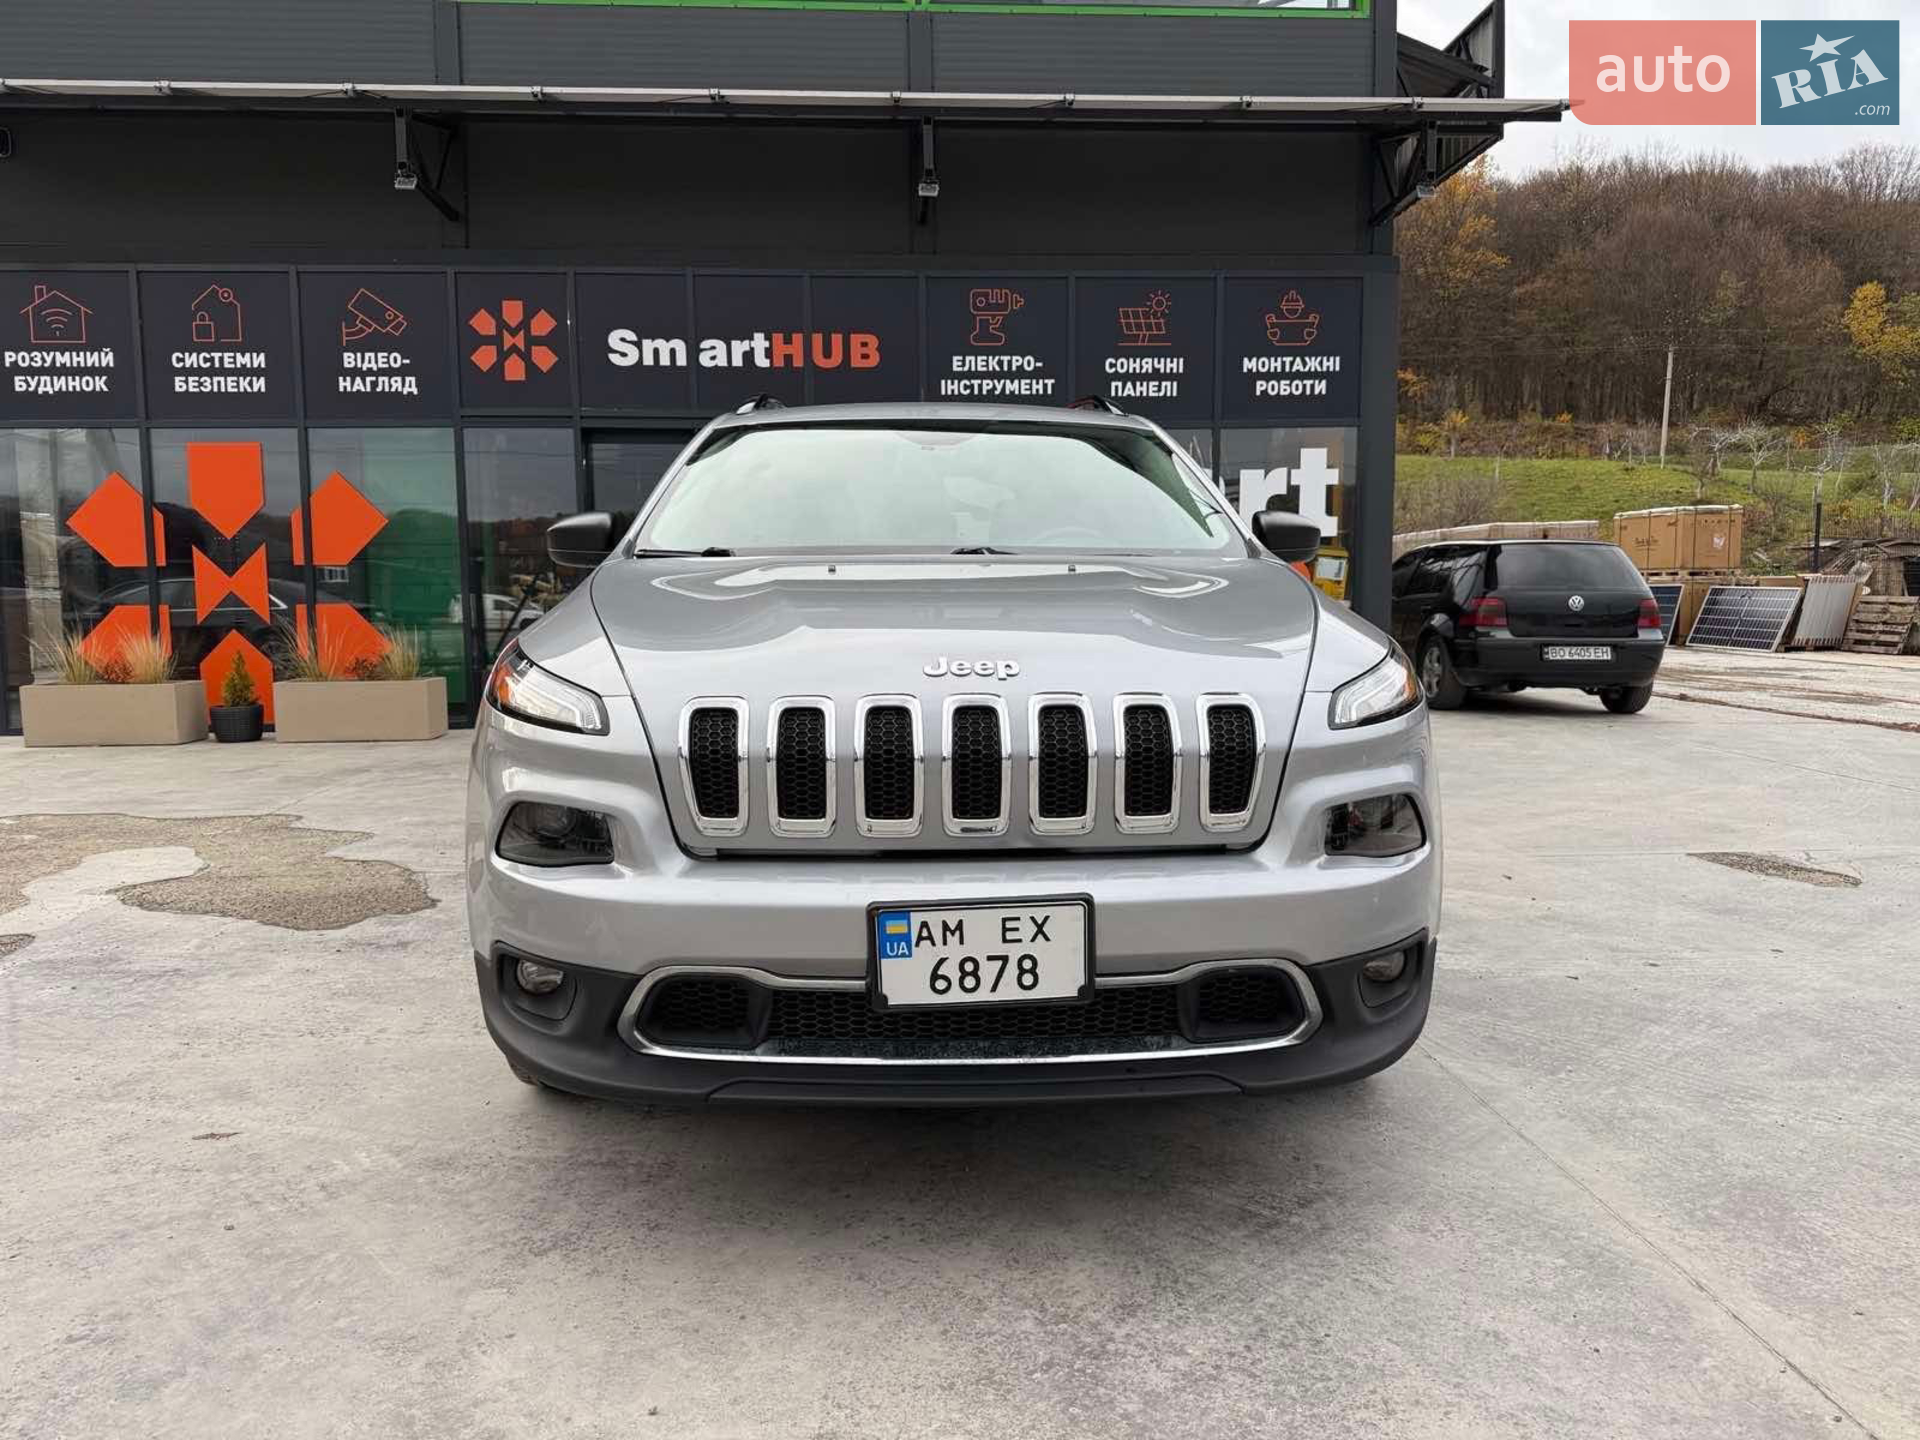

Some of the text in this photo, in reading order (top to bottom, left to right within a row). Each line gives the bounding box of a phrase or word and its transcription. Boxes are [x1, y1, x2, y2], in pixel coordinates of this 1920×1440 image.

[4, 347, 114, 368] РОЗУМНИЙ
[171, 351, 266, 369] СИСТЕМИ
[342, 351, 411, 371] ВІДЕО-
[952, 355, 1043, 372] ЕЛЕКТРО-
[1104, 357, 1184, 374] СОНЯЧНІ
[1242, 355, 1340, 373] МОНТАЖНІ
[14, 375, 109, 395] БУДИНОК
[174, 376, 266, 393] БЕЗПЕКИ
[338, 376, 418, 395] НАГЛЯД
[940, 378, 1056, 396] ІНСТРУМЕНТ
[1110, 380, 1178, 397] ПАНЕЛІ
[1255, 379, 1327, 396] РОБОТИ
[922, 656, 1021, 681] Jeep
[914, 915, 1051, 948] AM EX
[886, 941, 909, 956] UA
[929, 953, 1039, 996] 6878
